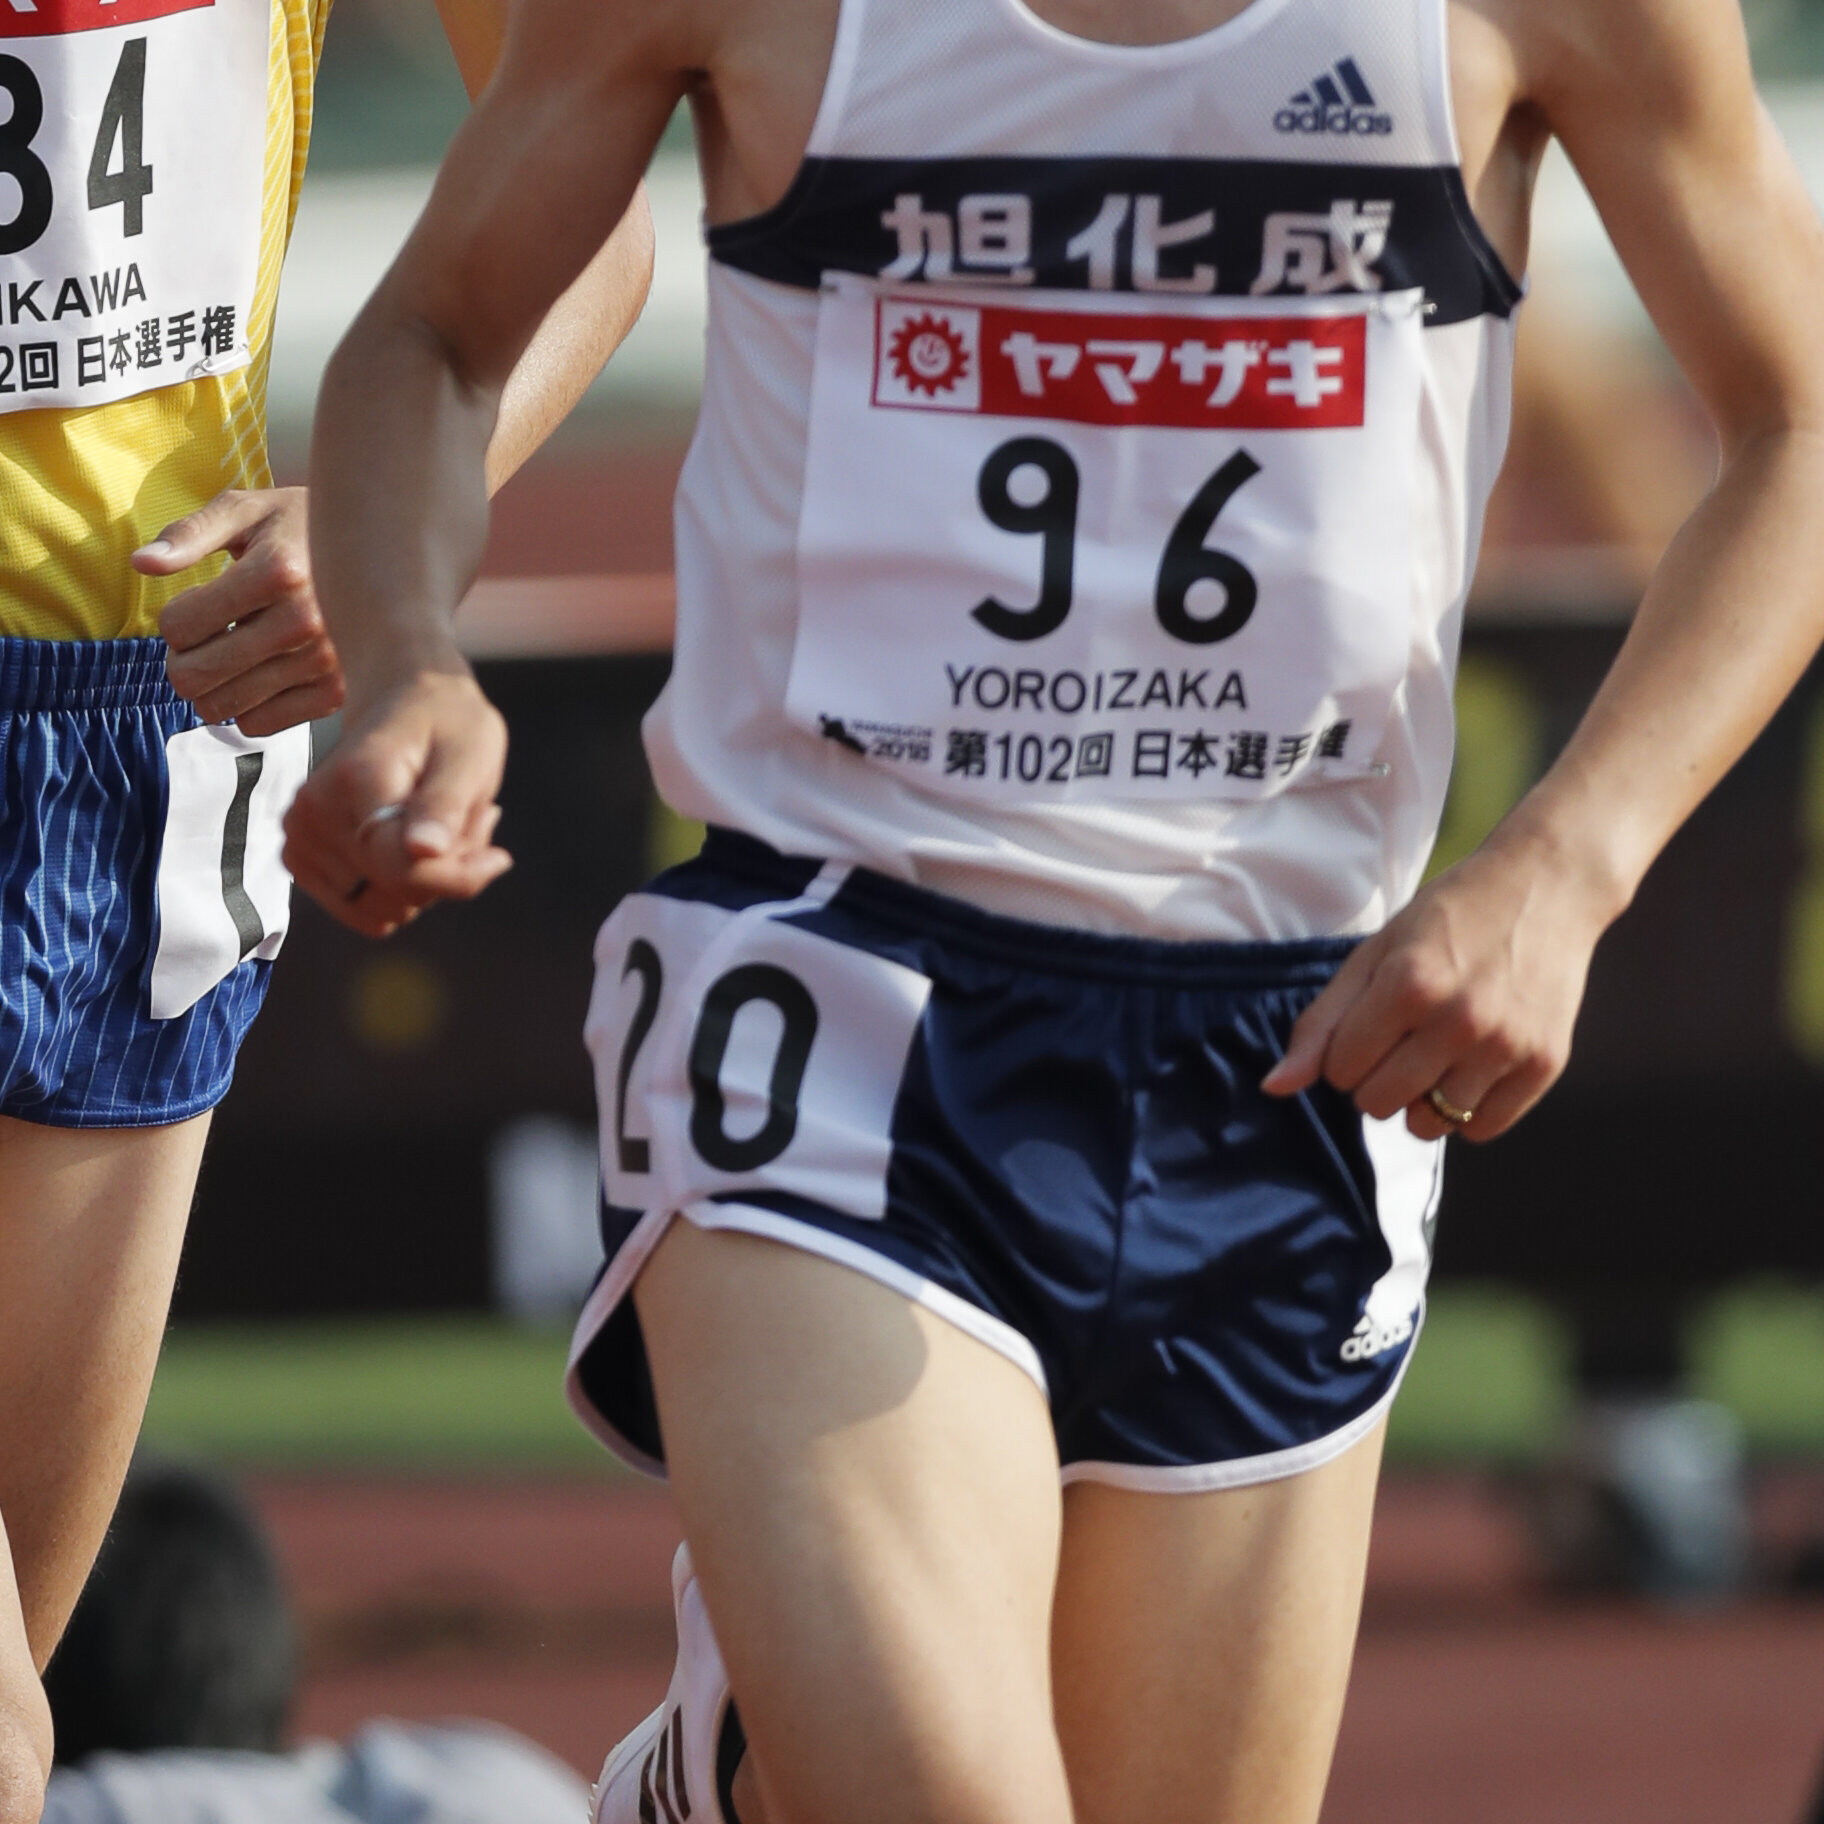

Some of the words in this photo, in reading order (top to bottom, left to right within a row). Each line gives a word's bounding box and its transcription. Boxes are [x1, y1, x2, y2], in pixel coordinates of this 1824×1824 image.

[1274, 105, 1392, 135] adidas
[879, 193, 1394, 295] 旭化成
[78, 305, 236, 387] 日本選手権
[1000, 331, 1343, 408] ヤマザキ
[970, 435, 1262, 646] 96
[945, 663, 1248, 713] YOROIZAKA
[944, 729, 1115, 783] 第102回
[618, 937, 818, 1173] 20
